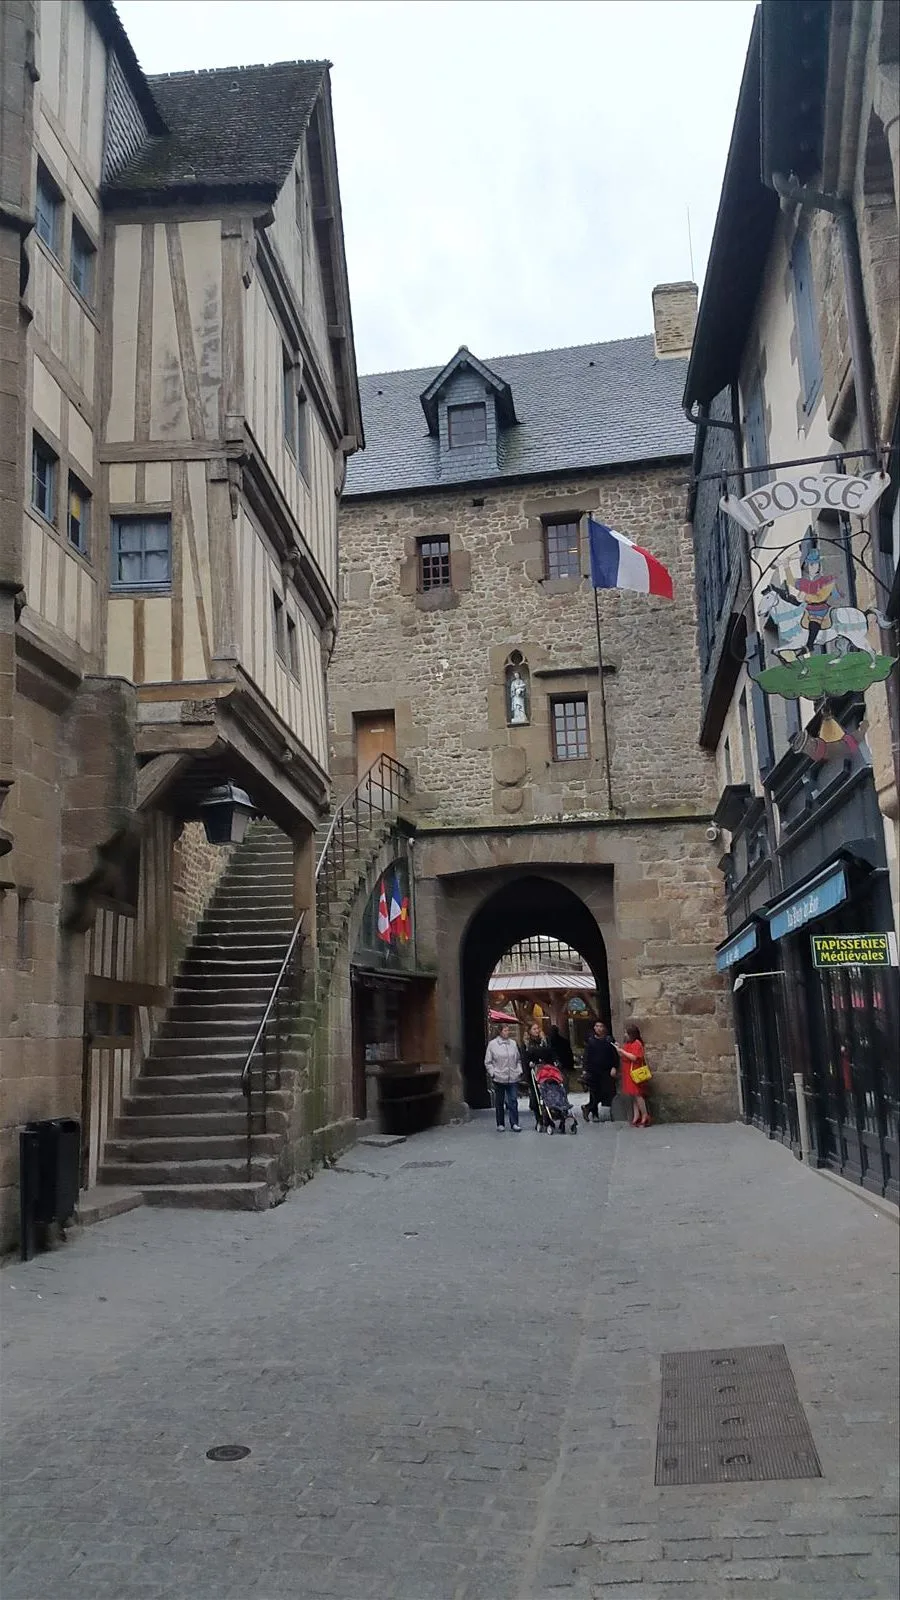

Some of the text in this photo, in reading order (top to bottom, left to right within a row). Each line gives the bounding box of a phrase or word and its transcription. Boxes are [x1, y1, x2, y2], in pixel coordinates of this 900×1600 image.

[744, 476, 869, 525] POSTE
[815, 939, 886, 951] TAPISSERIES
[820, 950, 885, 962] Médiévales
